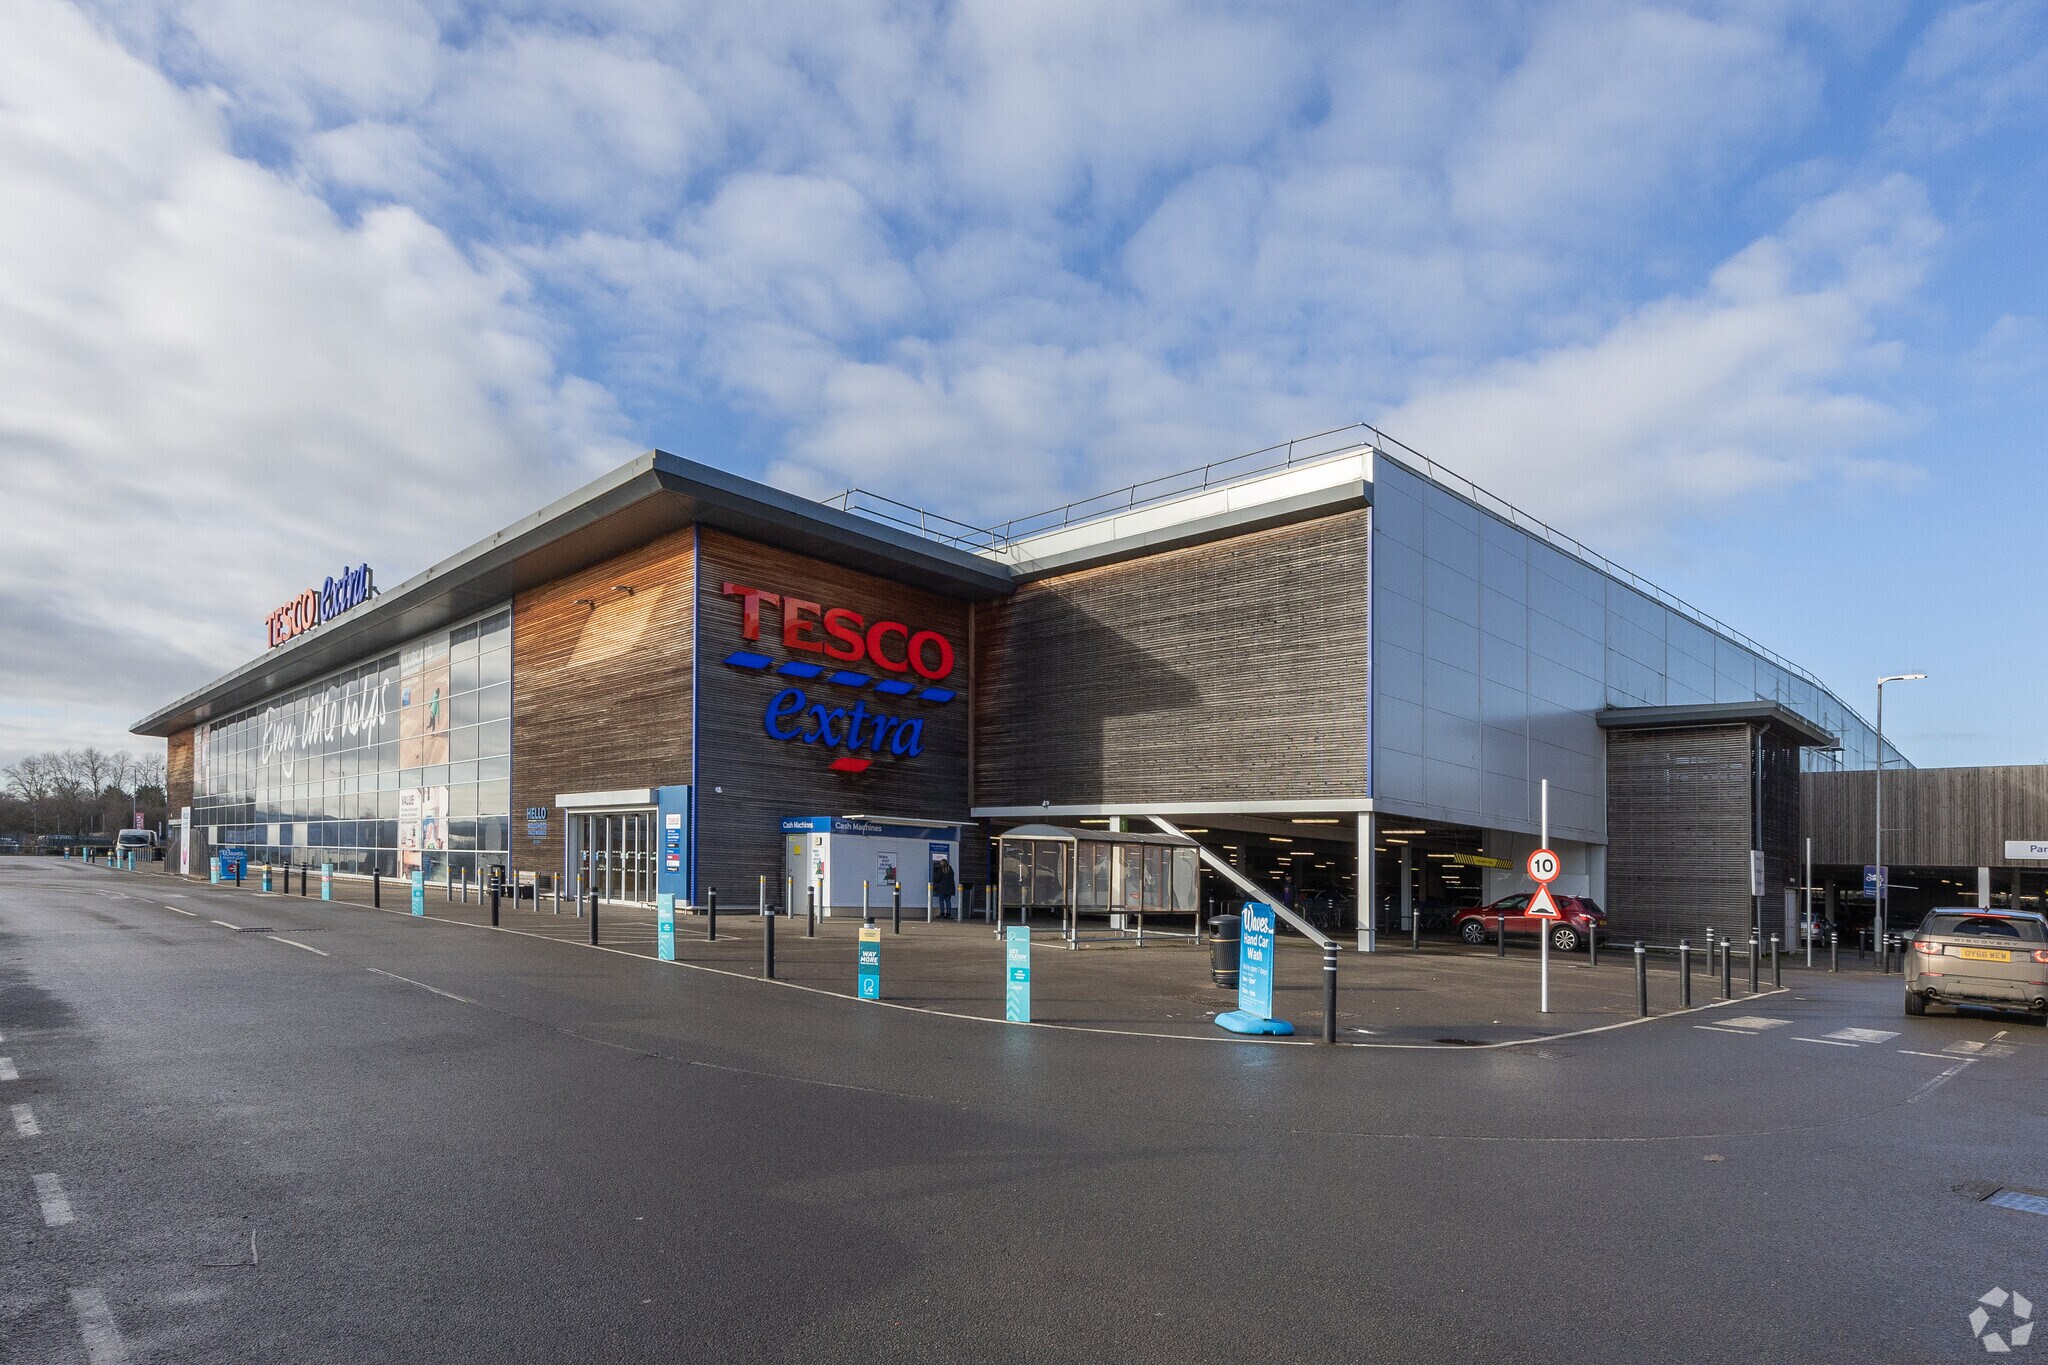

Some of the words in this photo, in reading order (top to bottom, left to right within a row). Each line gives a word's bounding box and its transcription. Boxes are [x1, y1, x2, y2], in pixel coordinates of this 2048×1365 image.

[265, 588, 316, 649] TESCO
[320, 563, 367, 622] extra
[722, 581, 955, 681] TESCO
[262, 706, 297, 778] Every
[302, 691, 337, 749] little
[342, 676, 390, 749] helps
[764, 687, 925, 758] extra
[527, 807, 547, 820] HELLO
[783, 821, 794, 829] Cash
[793, 821, 813, 829] Machines
[835, 821, 852, 831] Cash
[852, 823, 882, 832] Machines
[1535, 859, 1554, 873] 10
[1242, 904, 1270, 933] Waves
[1244, 933, 1257, 946] Hand
[1258, 935, 1269, 948] Car
[1955, 938, 2018, 946] DISCOVERY
[1247, 947, 1262, 961] Wash
